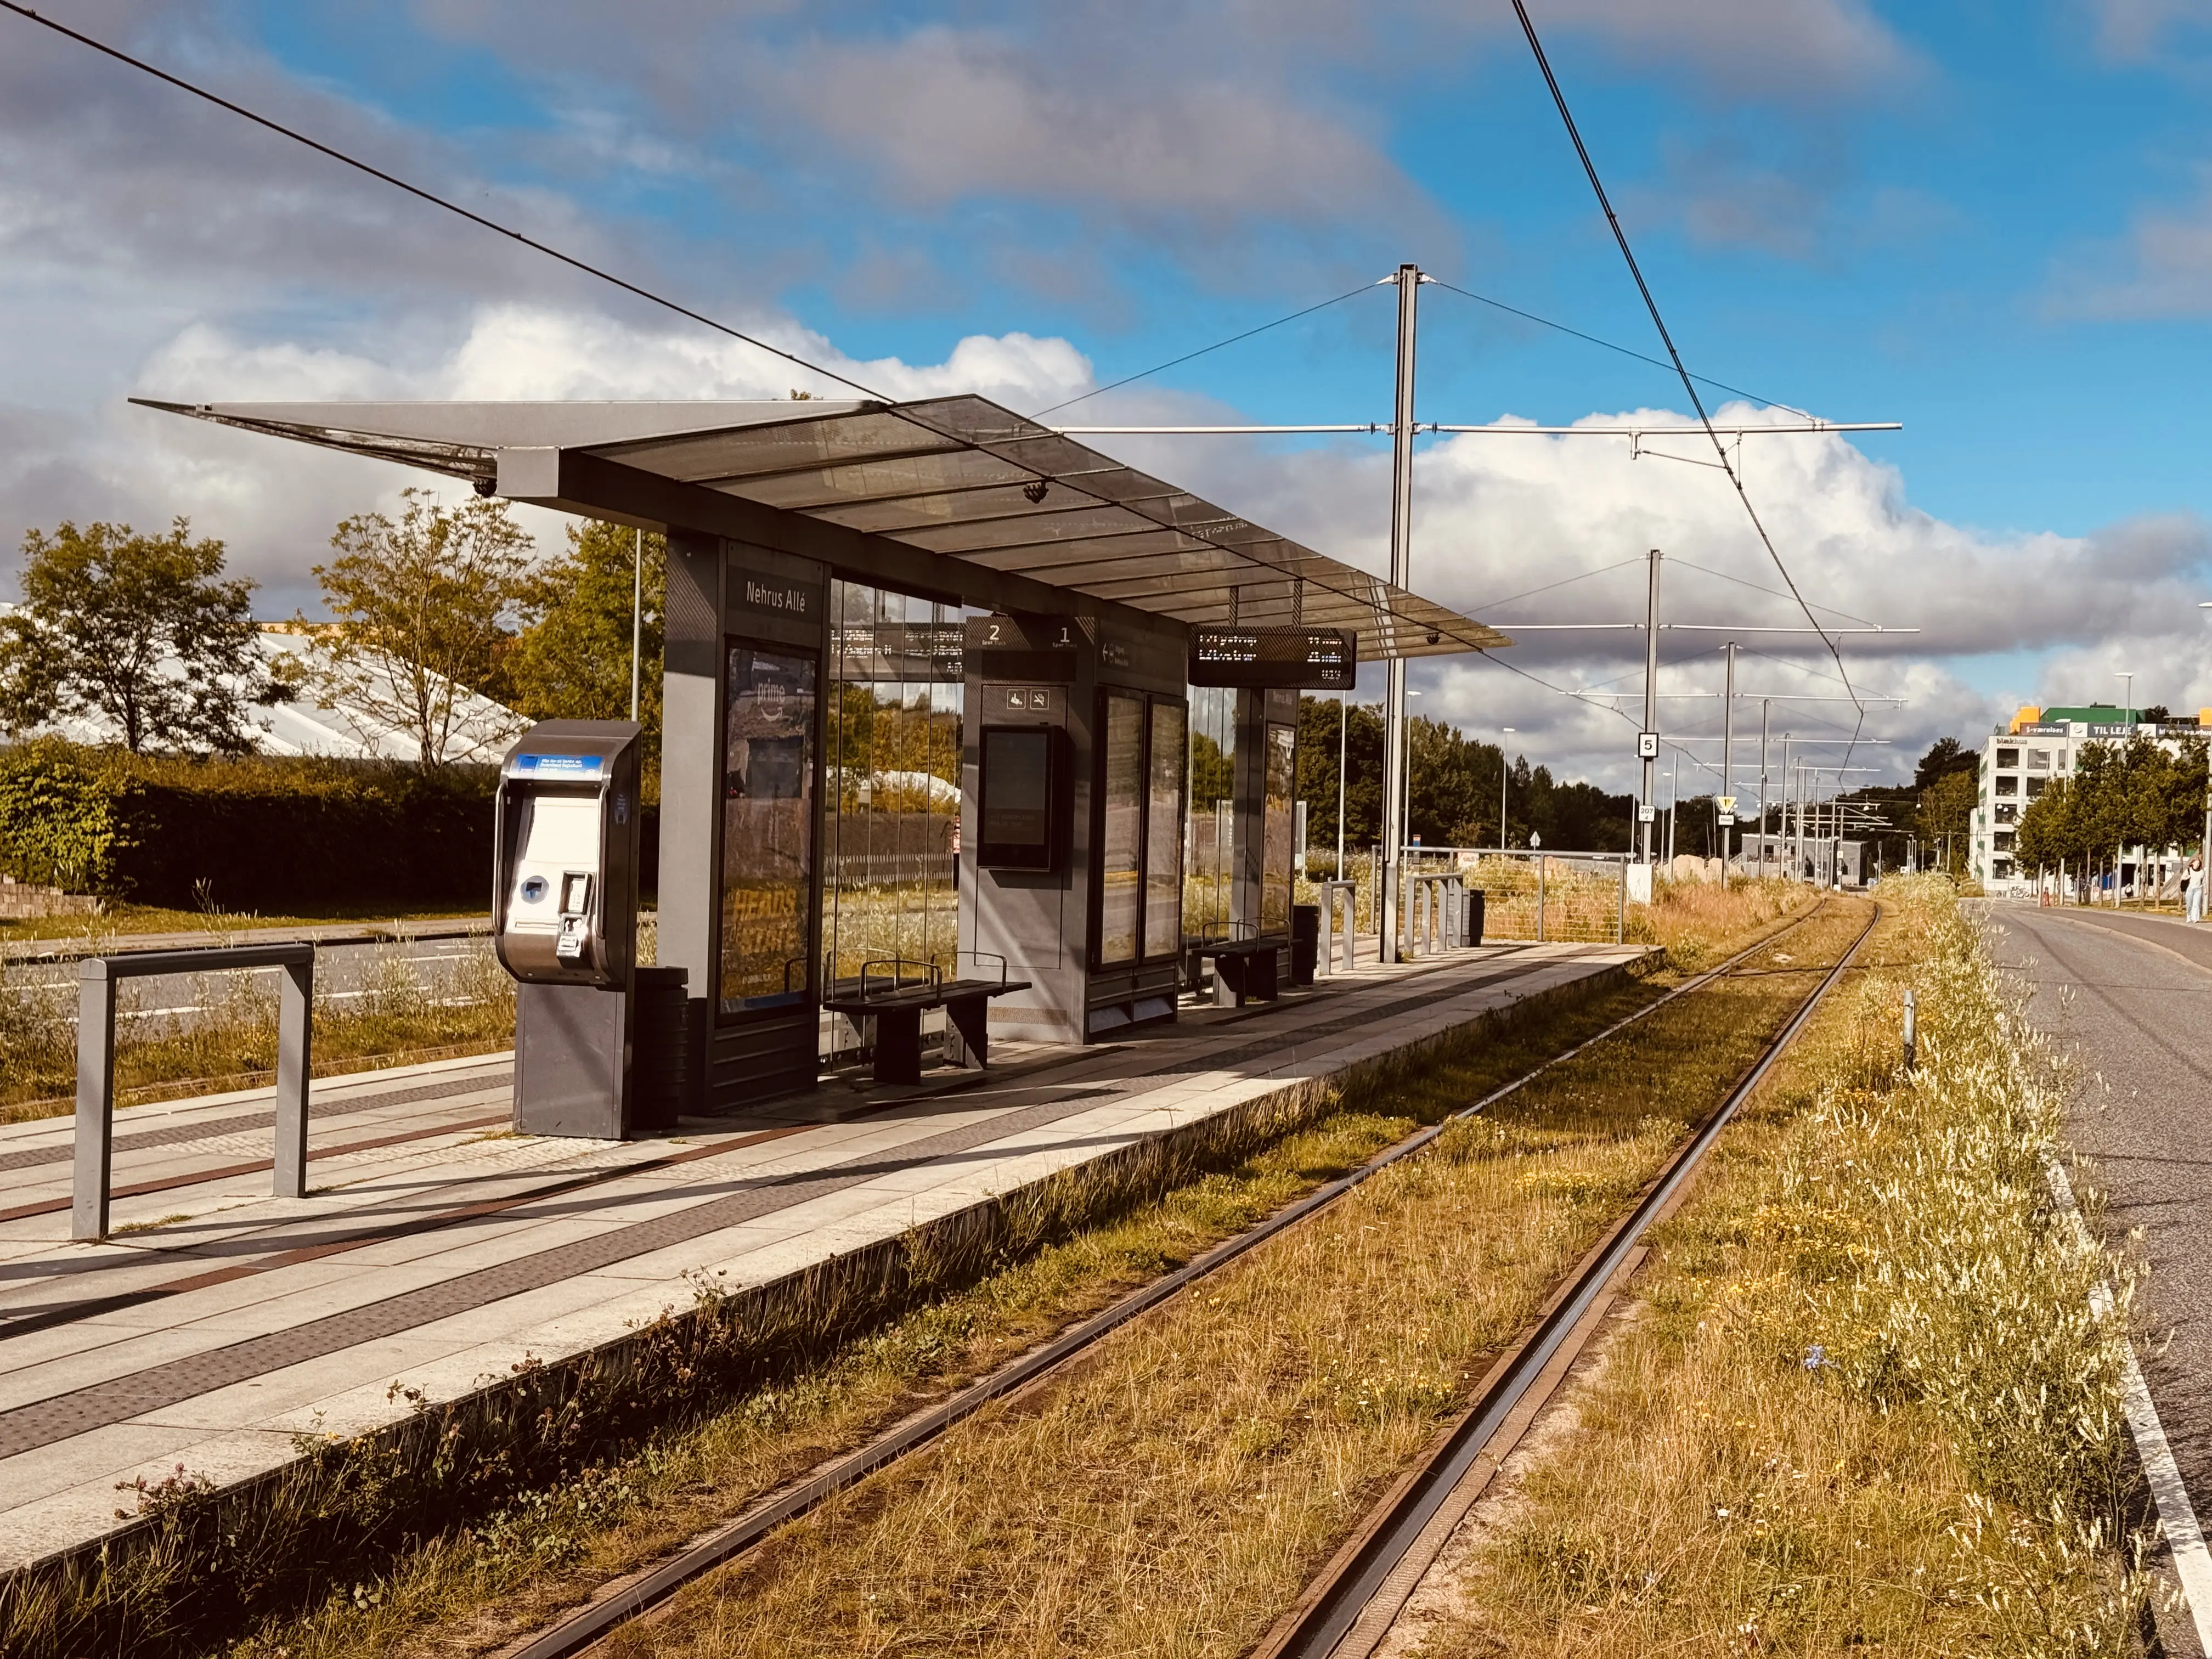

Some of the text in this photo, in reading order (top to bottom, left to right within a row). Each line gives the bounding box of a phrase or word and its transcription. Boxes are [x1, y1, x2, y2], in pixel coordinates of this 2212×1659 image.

[747, 580, 805, 613] Nehrus Allé
[989, 625, 1000, 641] 2
[1060, 627, 1070, 643] 1
[758, 677, 786, 706] prime
[2093, 726, 2132, 735] TIL LEJE
[1644, 740, 1652, 751] 5
